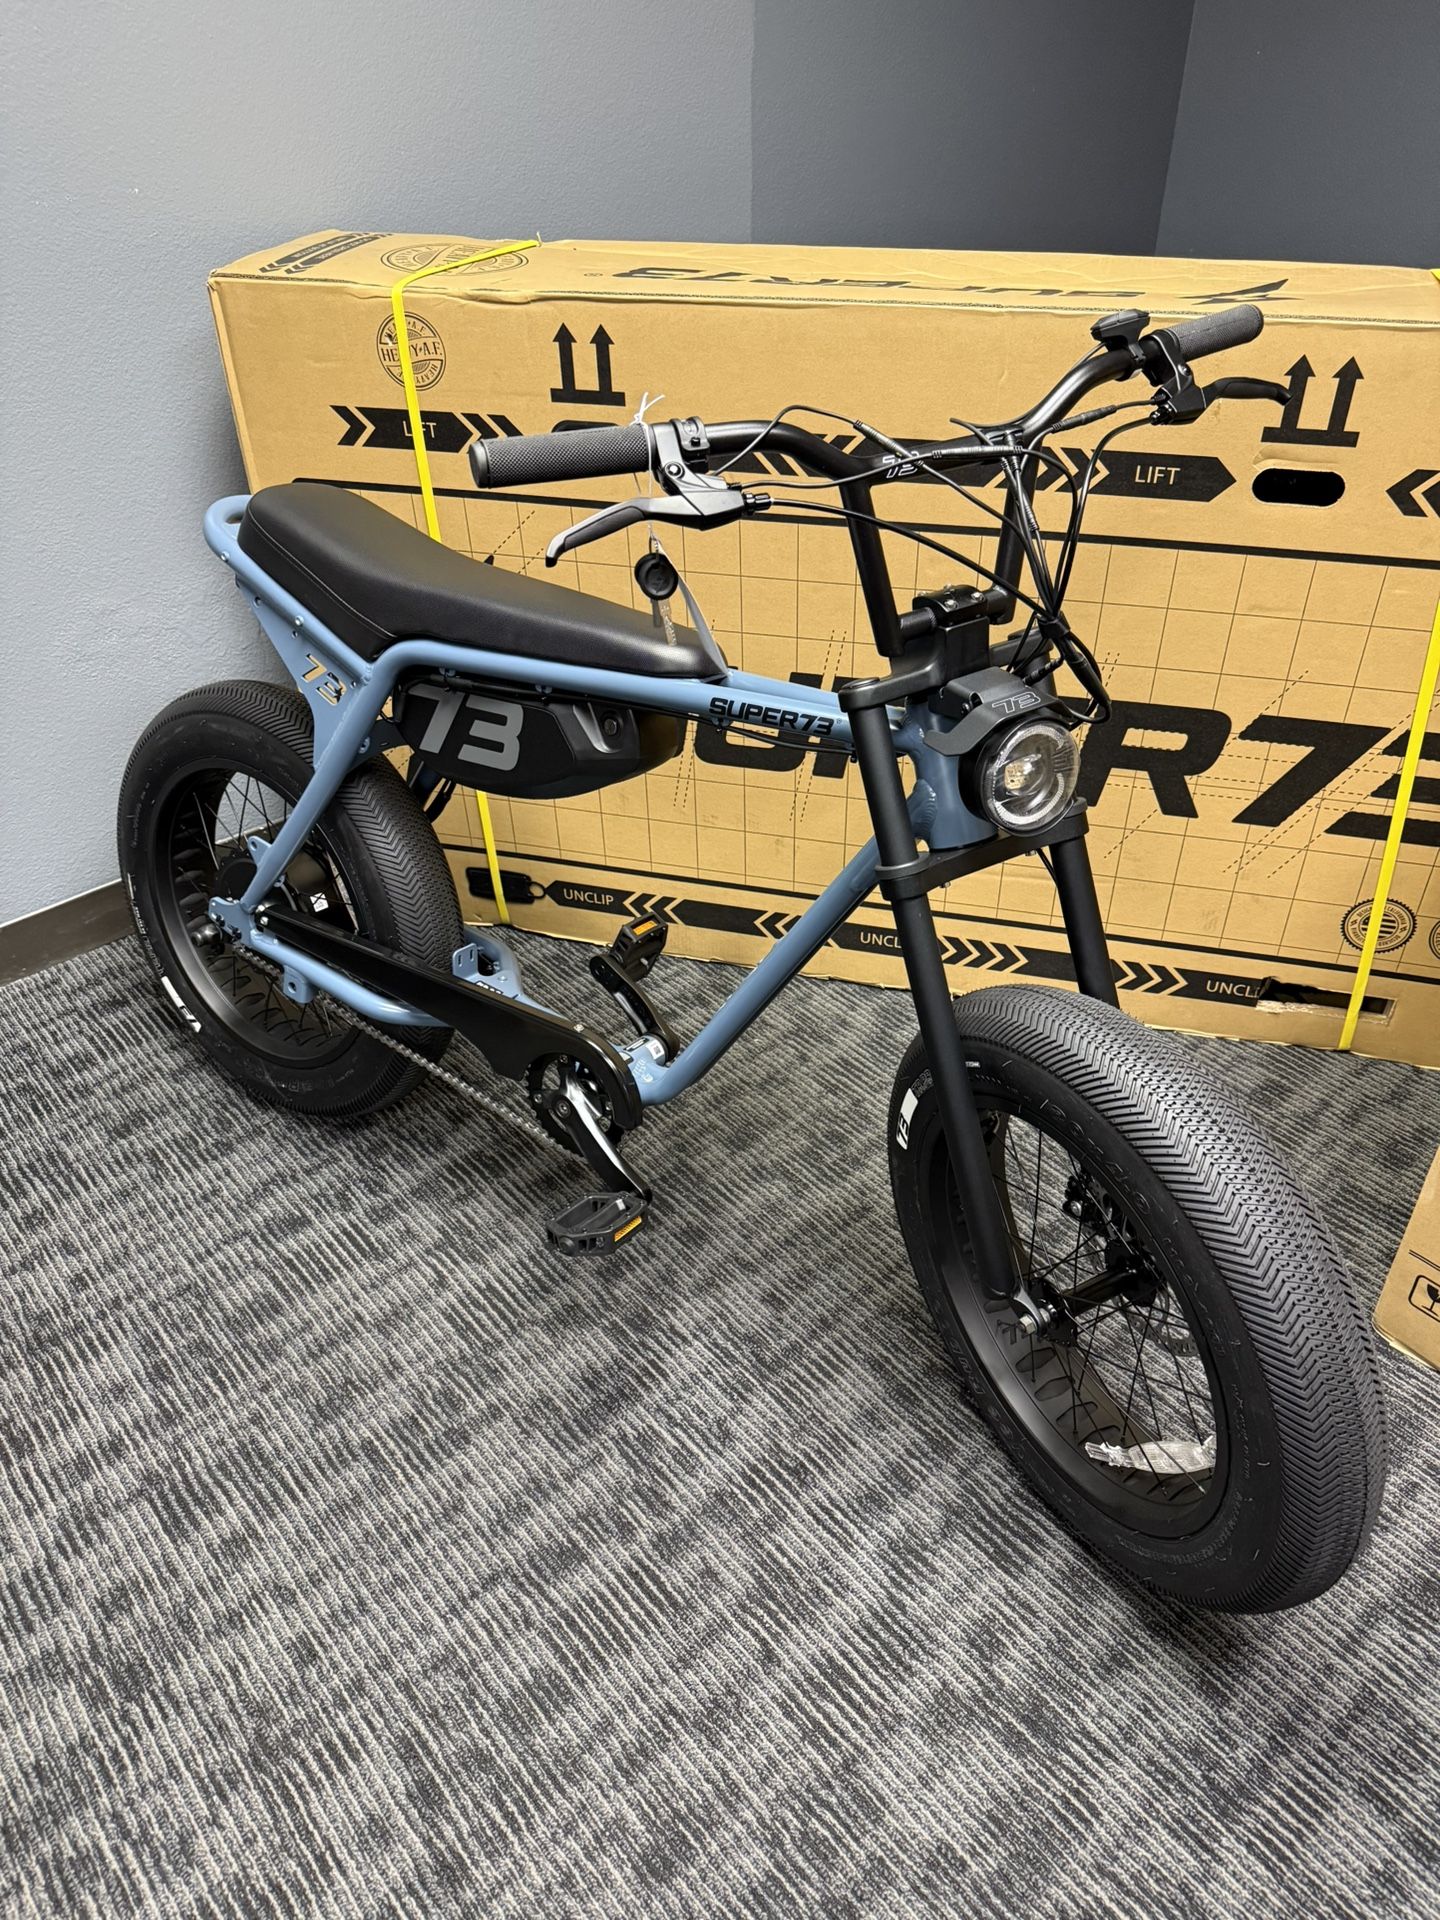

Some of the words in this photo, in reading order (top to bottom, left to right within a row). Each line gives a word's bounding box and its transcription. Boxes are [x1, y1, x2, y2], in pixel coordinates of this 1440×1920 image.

[612, 266, 1146, 297] SUPER73
[1135, 464, 1181, 485] LIFT
[301, 653, 347, 706] 73
[992, 691, 1041, 713] 73
[408, 683, 524, 771] 73
[709, 697, 835, 736] SUPER73
[563, 888, 614, 906] UNCLIP
[860, 931, 902, 948] UNCL
